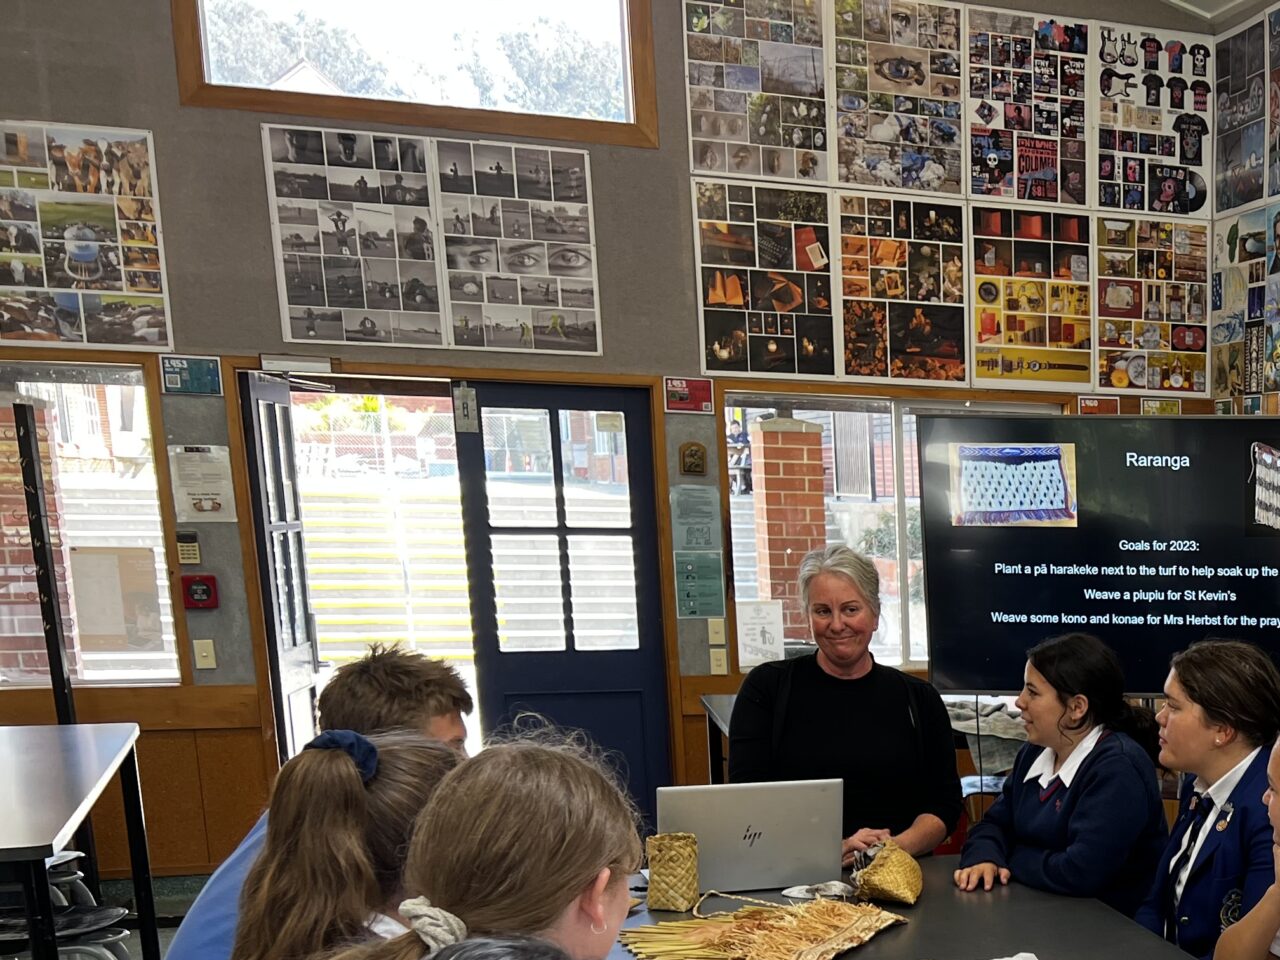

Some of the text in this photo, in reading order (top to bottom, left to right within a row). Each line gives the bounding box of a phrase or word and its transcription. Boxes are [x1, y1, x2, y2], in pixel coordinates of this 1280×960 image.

[1125, 451, 1190, 472] Raranga
[1118, 539, 1200, 552] Goals for 2023:
[994, 562, 1022, 575] Plant
[1049, 563, 1099, 575] harakeke
[1101, 564, 1124, 576] next
[1138, 564, 1157, 576] the
[1158, 565, 1177, 576] turf
[1191, 565, 1215, 580] help
[1216, 566, 1243, 577] soak
[1261, 565, 1279, 577] the
[1083, 588, 1121, 601] Weave
[1166, 589, 1182, 601] for
[1198, 590, 1237, 602] Kevin's
[990, 611, 1028, 624] Weave
[1029, 614, 1059, 625] some
[1061, 612, 1088, 624] kono
[1089, 613, 1110, 625] and
[1111, 613, 1145, 626] konae
[1146, 613, 1162, 626] for
[1163, 614, 1184, 626] Mrs
[1186, 614, 1221, 626] Herbst
[1222, 614, 1239, 626] for
[1240, 615, 1258, 626] the
[742, 824, 763, 848] hp
